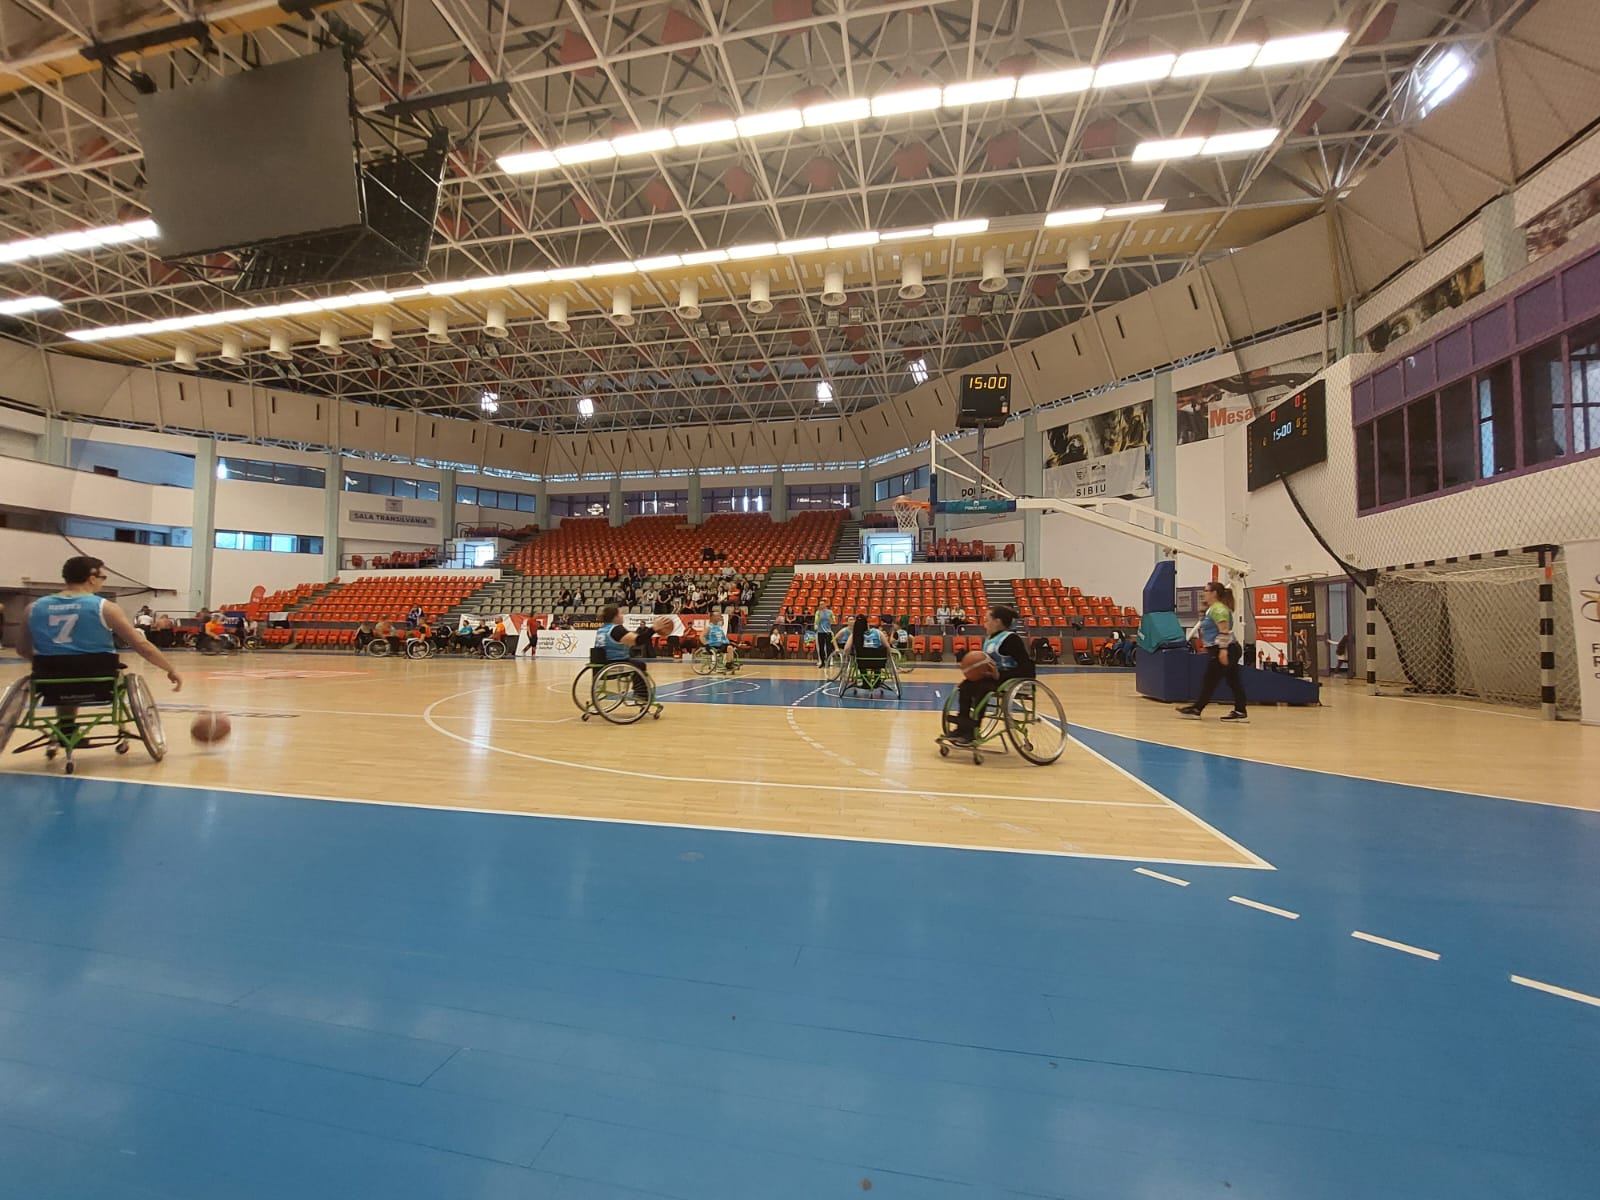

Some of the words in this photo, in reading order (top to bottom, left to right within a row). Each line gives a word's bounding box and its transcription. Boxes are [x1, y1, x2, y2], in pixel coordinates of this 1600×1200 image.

[969, 376, 1008, 389] 15:00
[1210, 406, 1255, 429] Mesa
[1075, 483, 1107, 497] SIBIU
[353, 513, 374, 521] SALA
[375, 514, 428, 524] TRANSILVANIA
[1260, 607, 1279, 615] ACCES
[48, 613, 79, 643] 7
